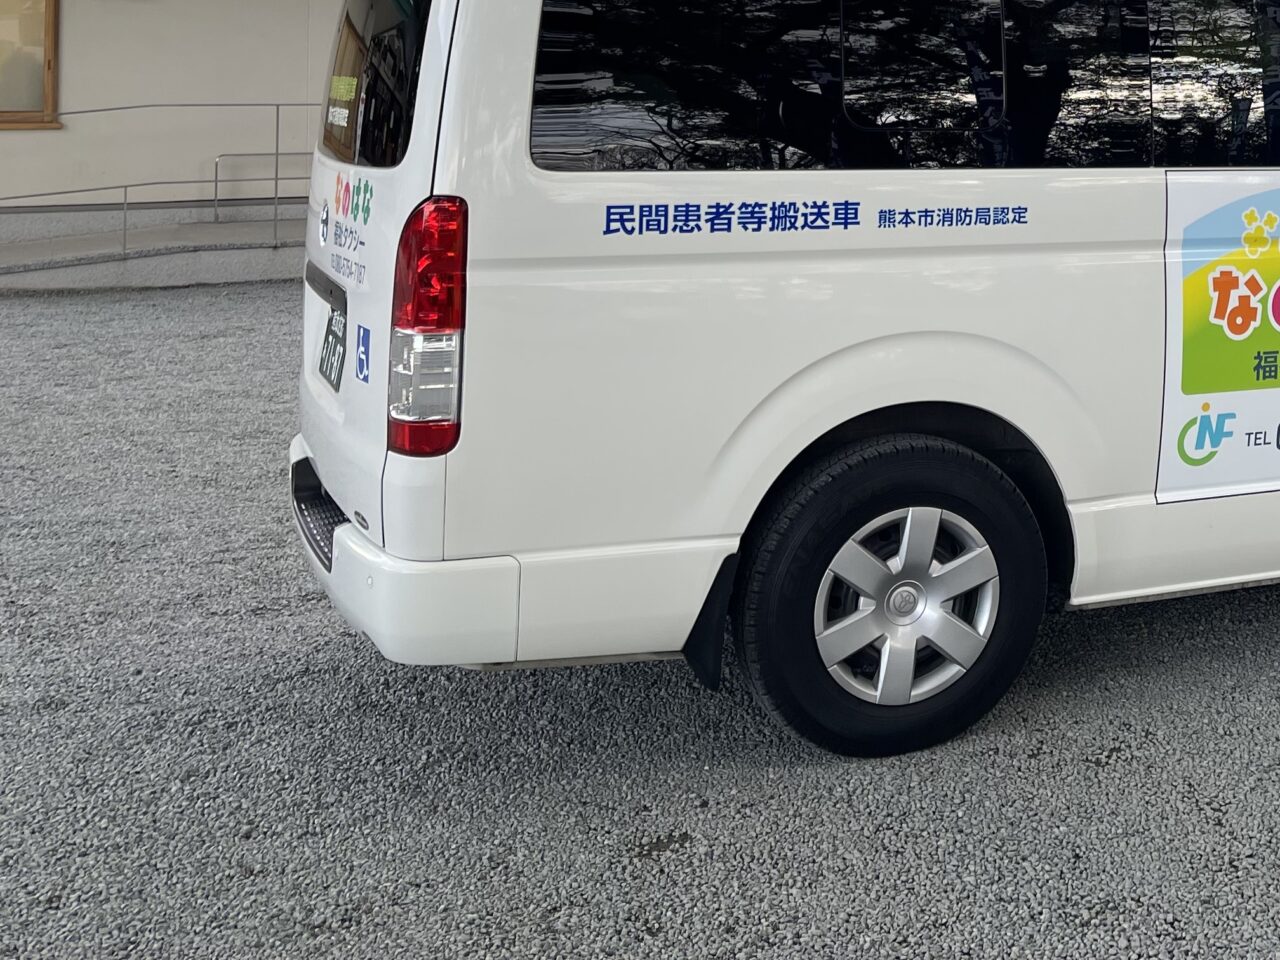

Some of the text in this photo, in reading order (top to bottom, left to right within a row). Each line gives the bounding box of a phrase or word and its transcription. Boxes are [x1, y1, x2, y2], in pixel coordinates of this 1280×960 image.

[334, 171, 374, 226] なのはな
[602, 200, 861, 236] 民間患者等搬送車
[877, 205, 1029, 228] 熊本市消防局認定
[1245, 431, 1272, 448] TEL
